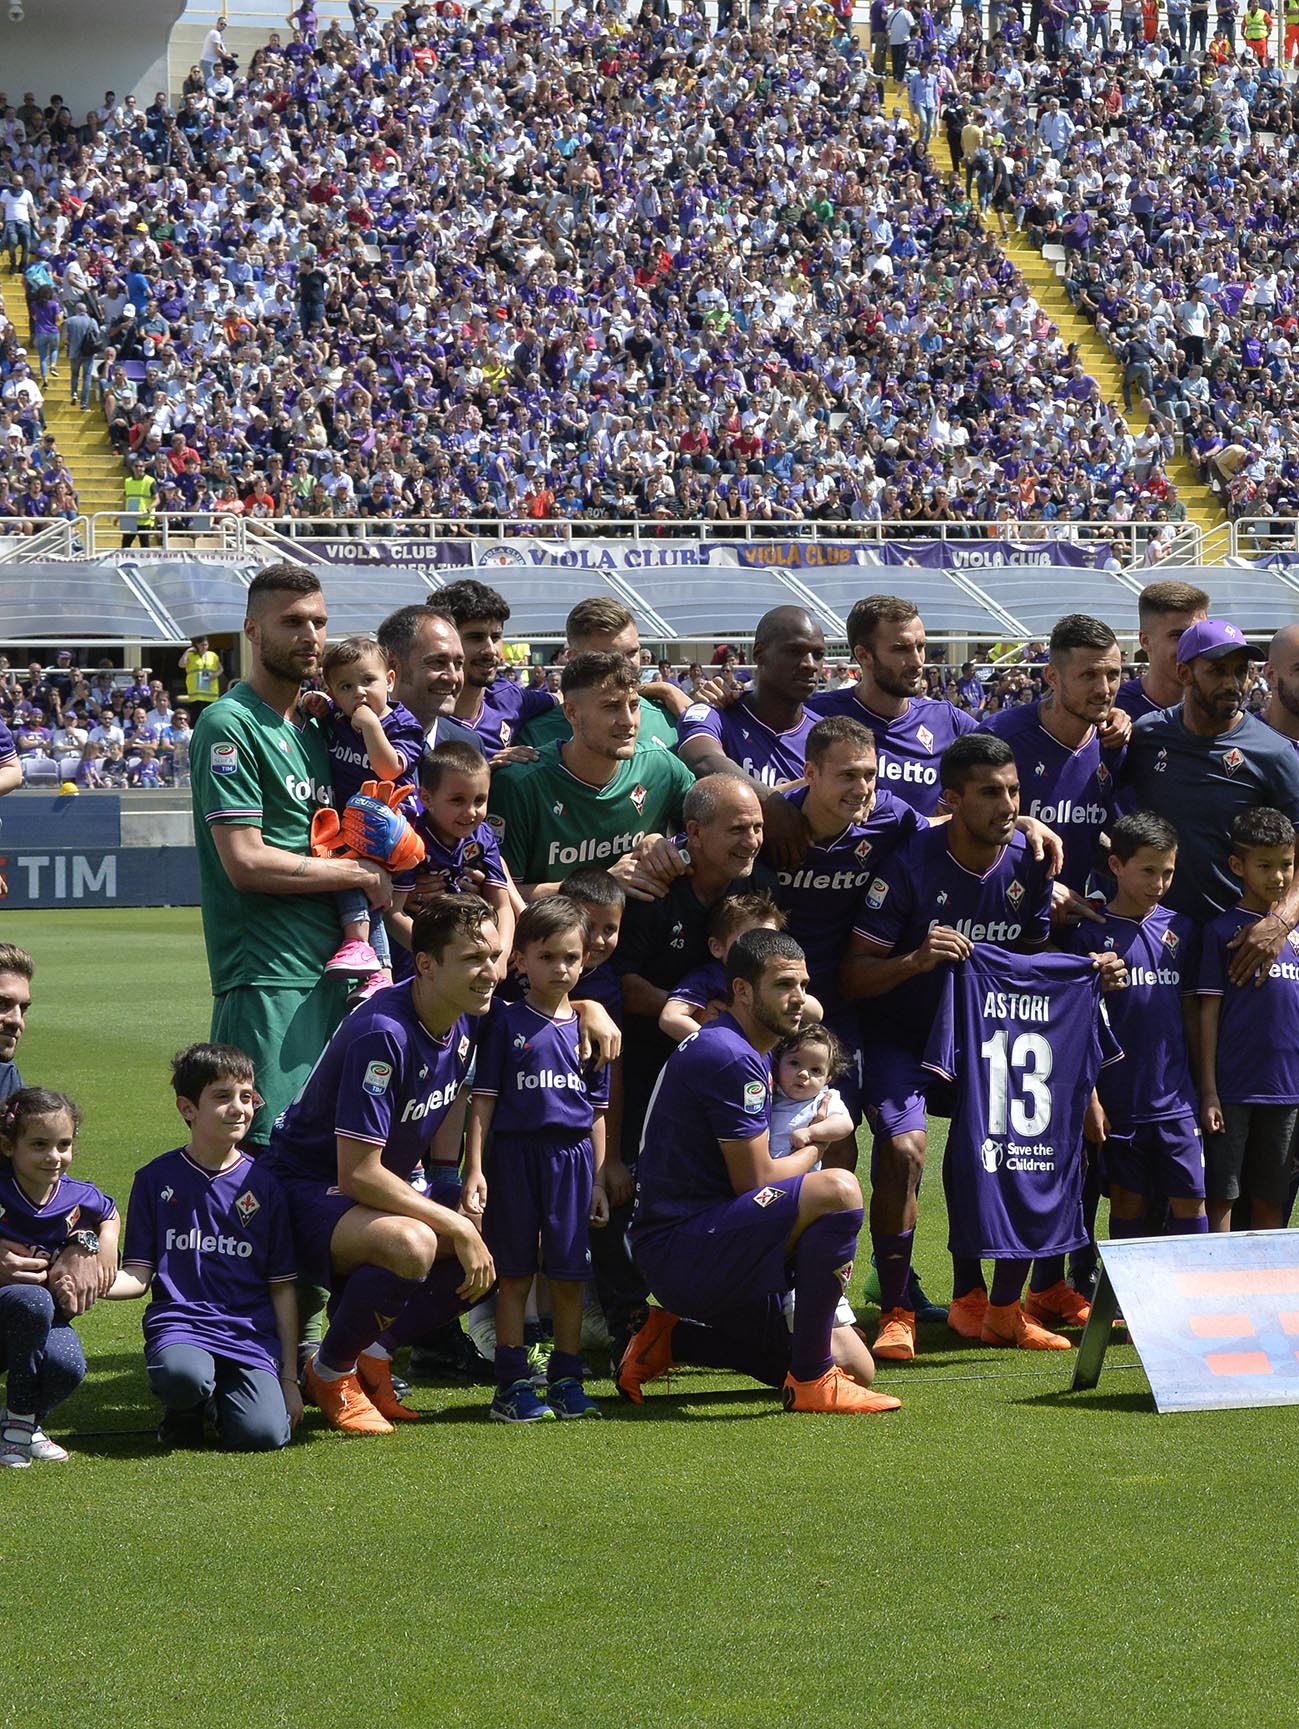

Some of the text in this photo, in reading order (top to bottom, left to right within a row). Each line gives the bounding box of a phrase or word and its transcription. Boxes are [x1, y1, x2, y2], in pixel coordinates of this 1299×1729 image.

[326, 545, 437, 559] VIOLA CLUB
[528, 549, 698, 568] VIOLA CLUB
[746, 544, 849, 565] VIOLA CLUB
[952, 552, 1051, 567] VIOLA CLUB
[1154, 762, 1167, 774] 42
[1030, 800, 1107, 824] folletto
[549, 831, 645, 865] folletto
[18, 855, 117, 898] TIM
[670, 938, 685, 949] 43
[984, 992, 1049, 1022] ASTORI
[517, 1070, 587, 1092] folletto
[981, 1030, 1053, 1137] 13
[1007, 1142, 1054, 1156] Save the
[1006, 1157, 1055, 1171] Children
[165, 1228, 252, 1258] folletto
